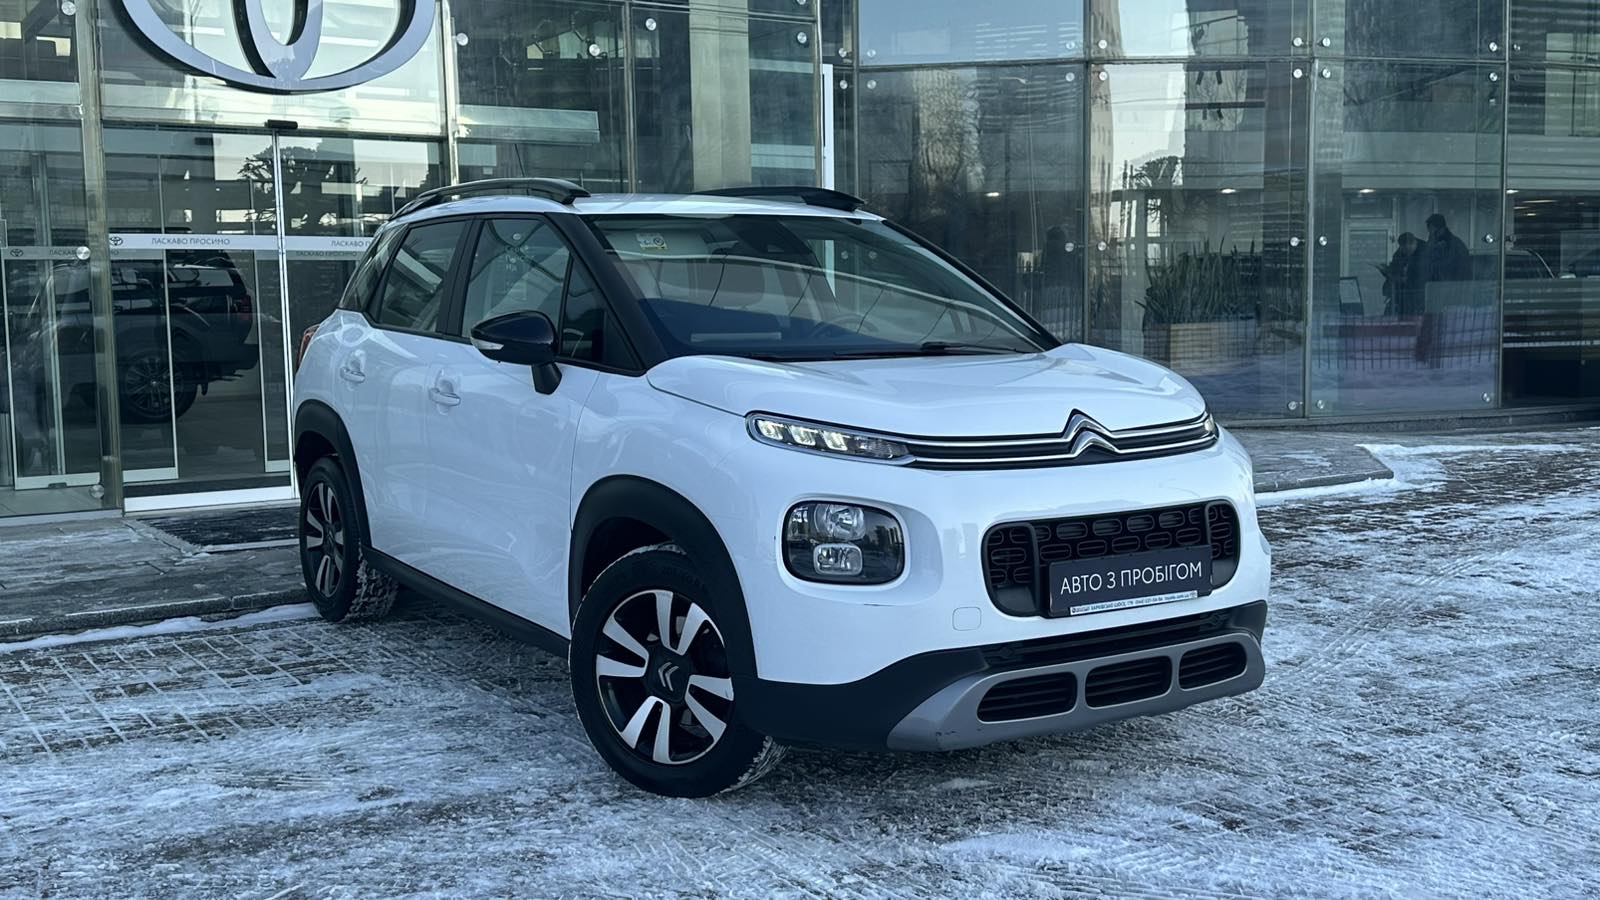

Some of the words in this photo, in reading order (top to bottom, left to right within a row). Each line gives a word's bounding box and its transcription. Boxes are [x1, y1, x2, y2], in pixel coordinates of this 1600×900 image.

[151, 237, 188, 245] ЛАСКАВО
[189, 238, 231, 246] ПРОСИМО
[331, 240, 365, 248] ЛАСКАВО
[1060, 573, 1103, 595] АВТО
[1120, 561, 1202, 588] ПРОБІГОМ
